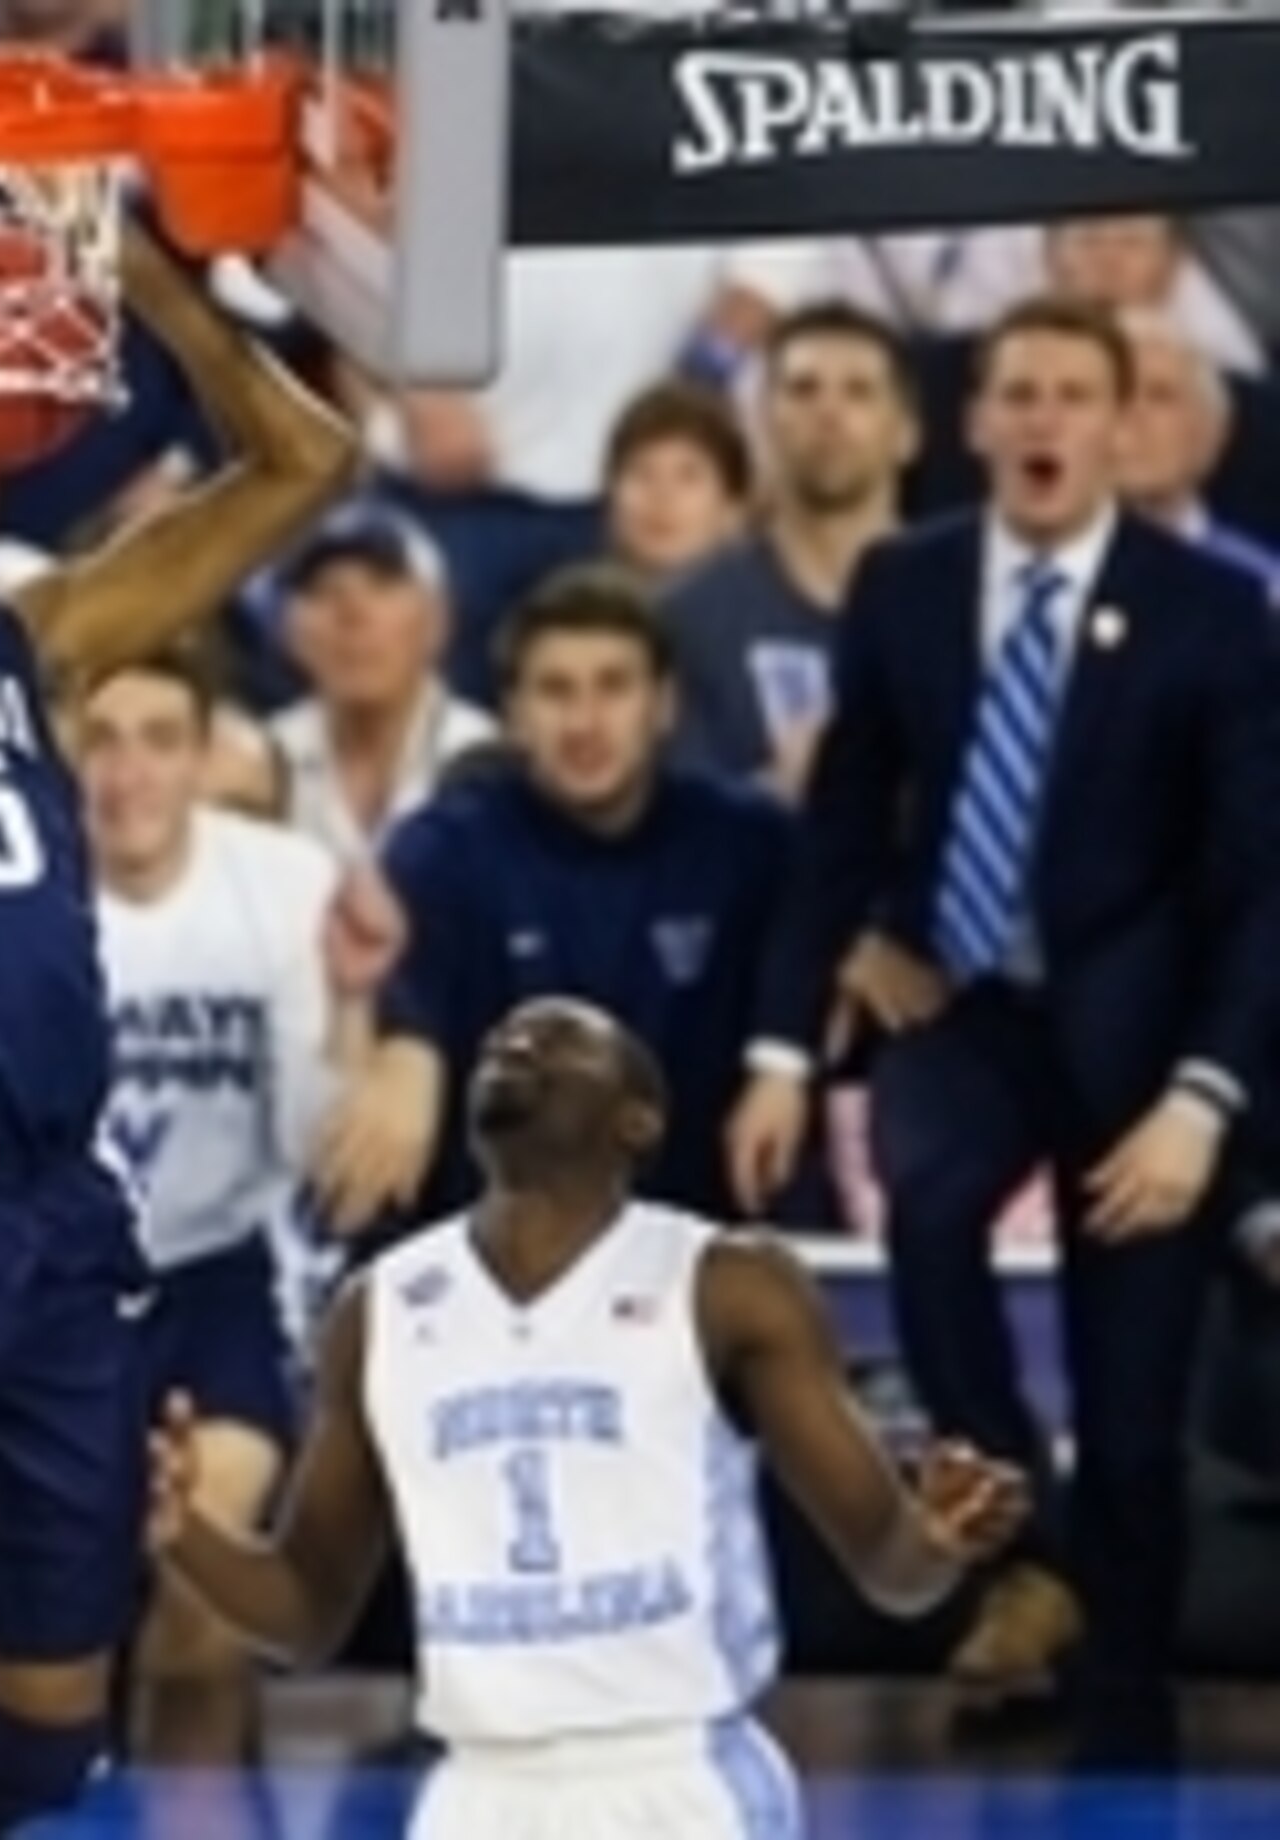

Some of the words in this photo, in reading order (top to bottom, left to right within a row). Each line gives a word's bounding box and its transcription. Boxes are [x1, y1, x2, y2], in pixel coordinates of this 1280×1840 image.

[673, 34, 1193, 173] SPALDING
[429, 1378, 625, 1460] NORTH
[503, 1448, 559, 1573] 1
